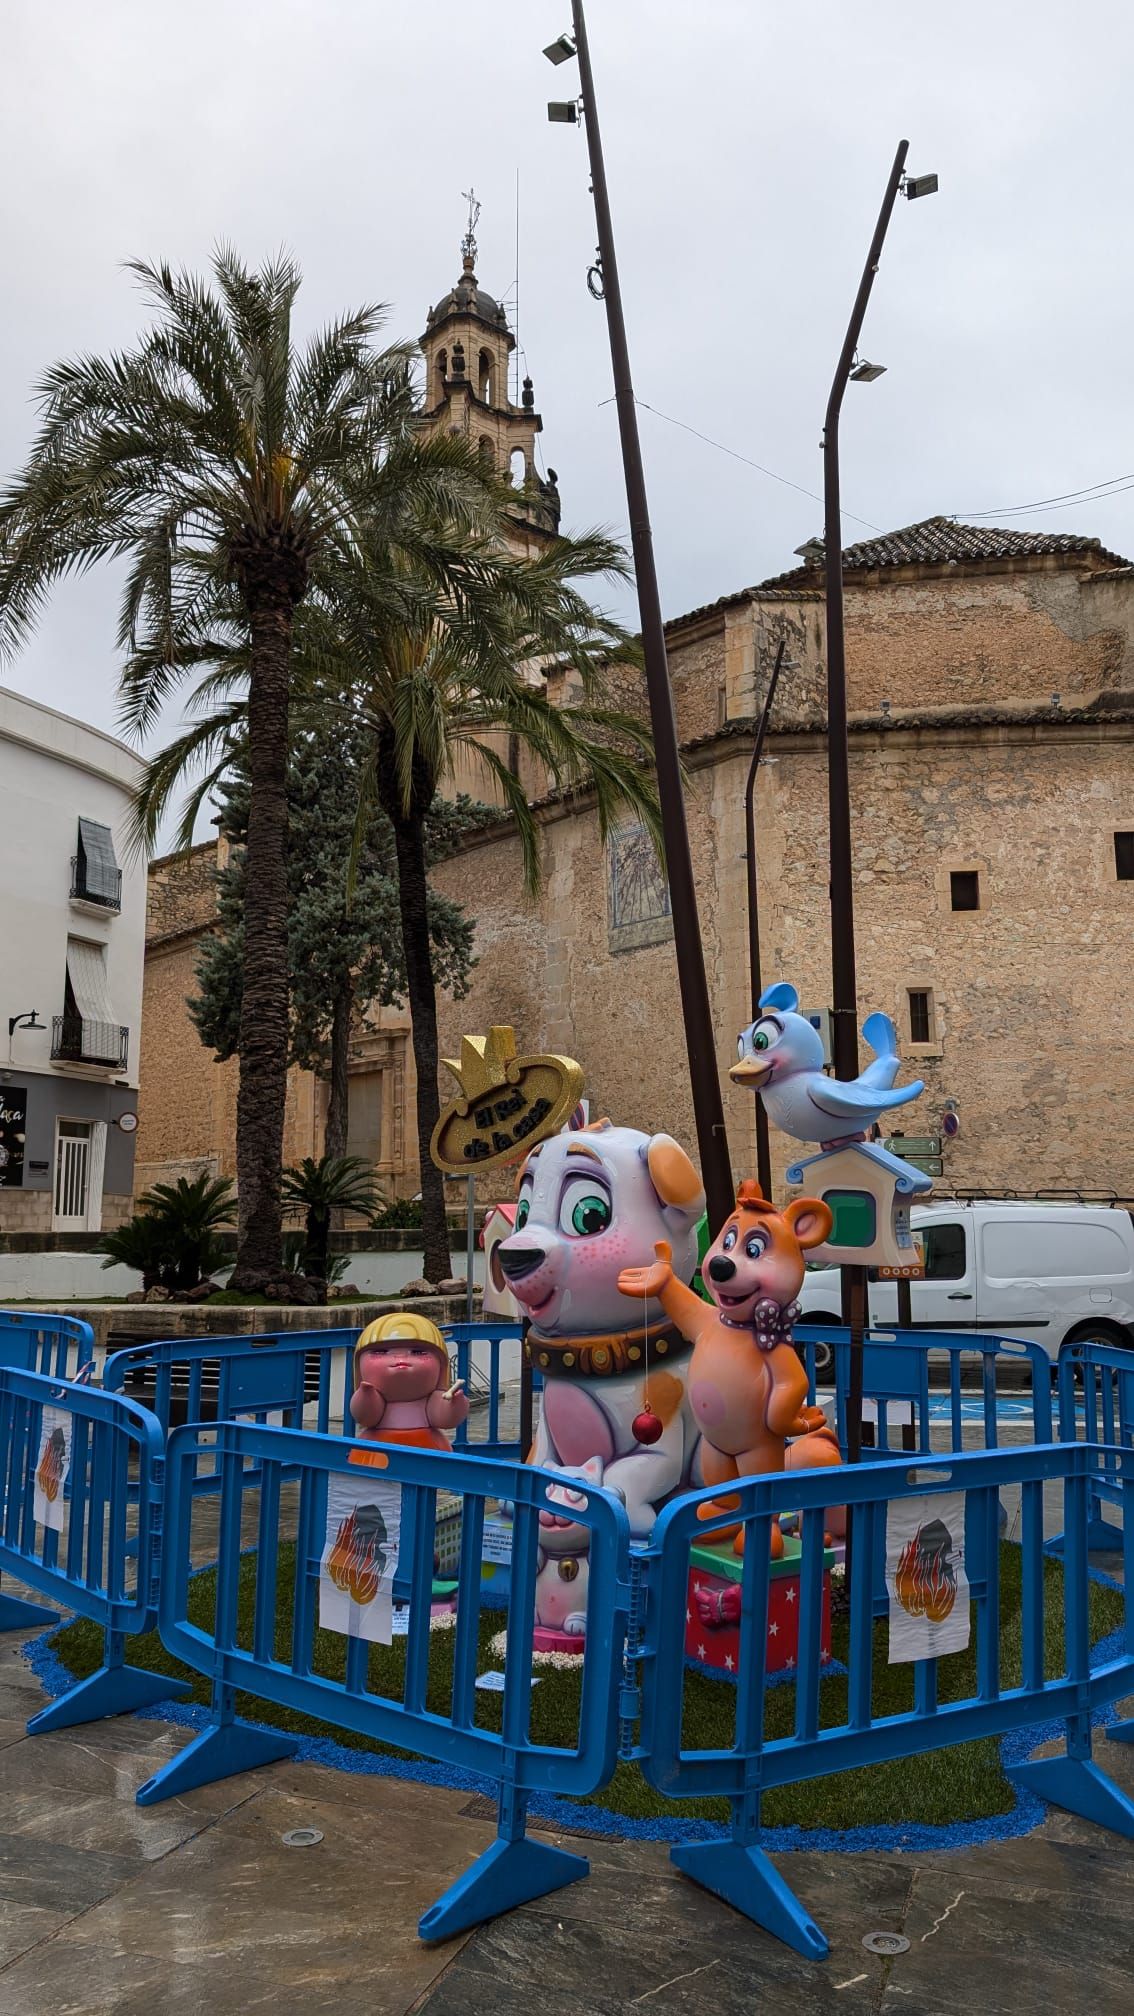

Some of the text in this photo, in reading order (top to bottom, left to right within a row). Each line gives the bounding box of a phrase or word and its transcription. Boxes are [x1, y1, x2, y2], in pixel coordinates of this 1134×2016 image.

[475, 1088, 528, 1130] El Rei
[464, 1138, 490, 1158] de
[492, 1131, 514, 1151] la
